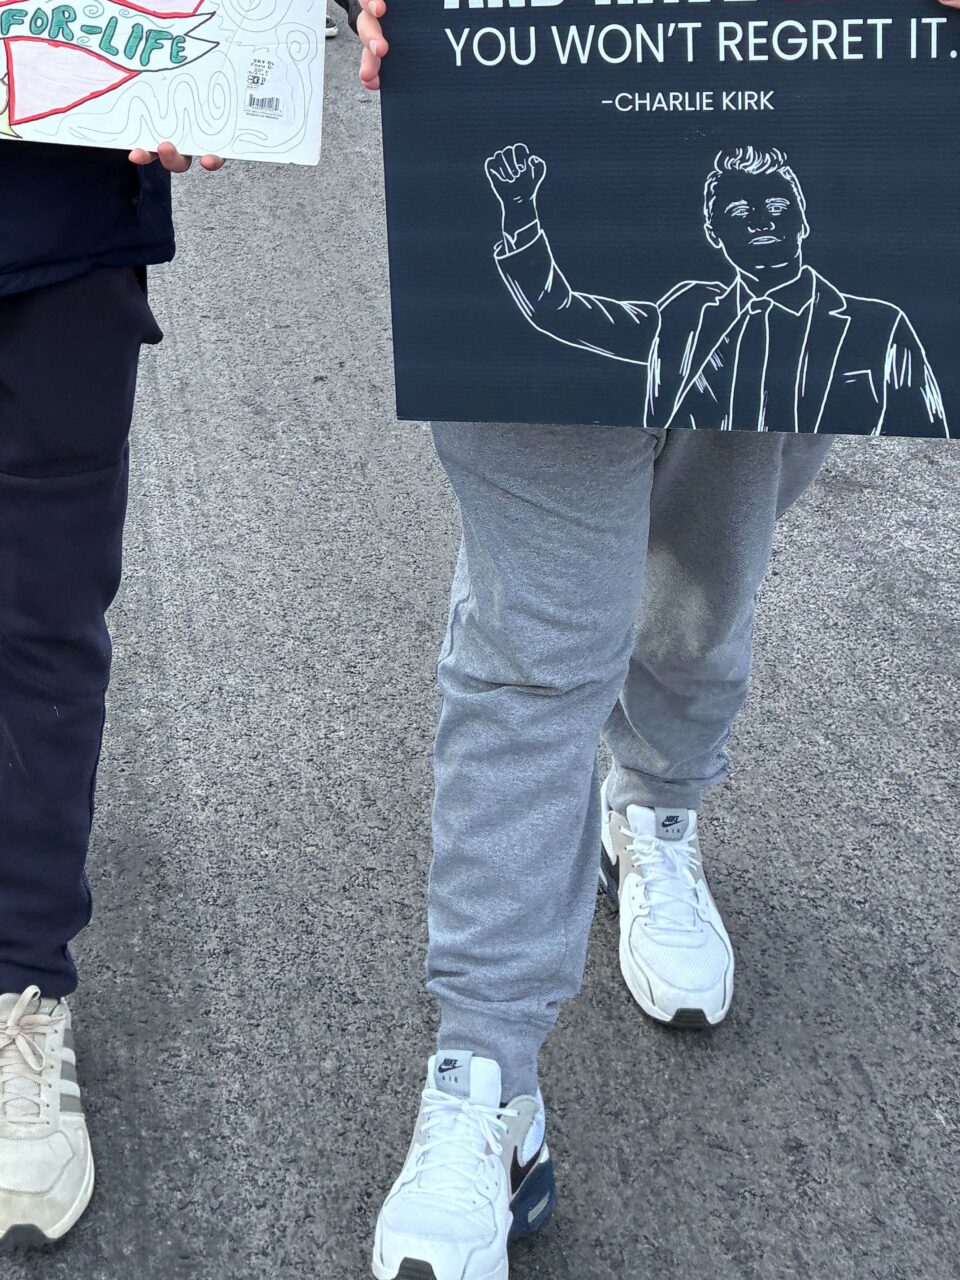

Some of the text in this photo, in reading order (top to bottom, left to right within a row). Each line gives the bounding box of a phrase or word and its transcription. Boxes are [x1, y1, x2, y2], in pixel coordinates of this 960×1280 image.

[0, 5, 188, 65] FOR-LIFE
[444, 25, 537, 67] YOU
[719, 17, 893, 62] REGRET
[909, 17, 959, 60] IT.
[601, 90, 775, 113] -CHARLIE KIRK
